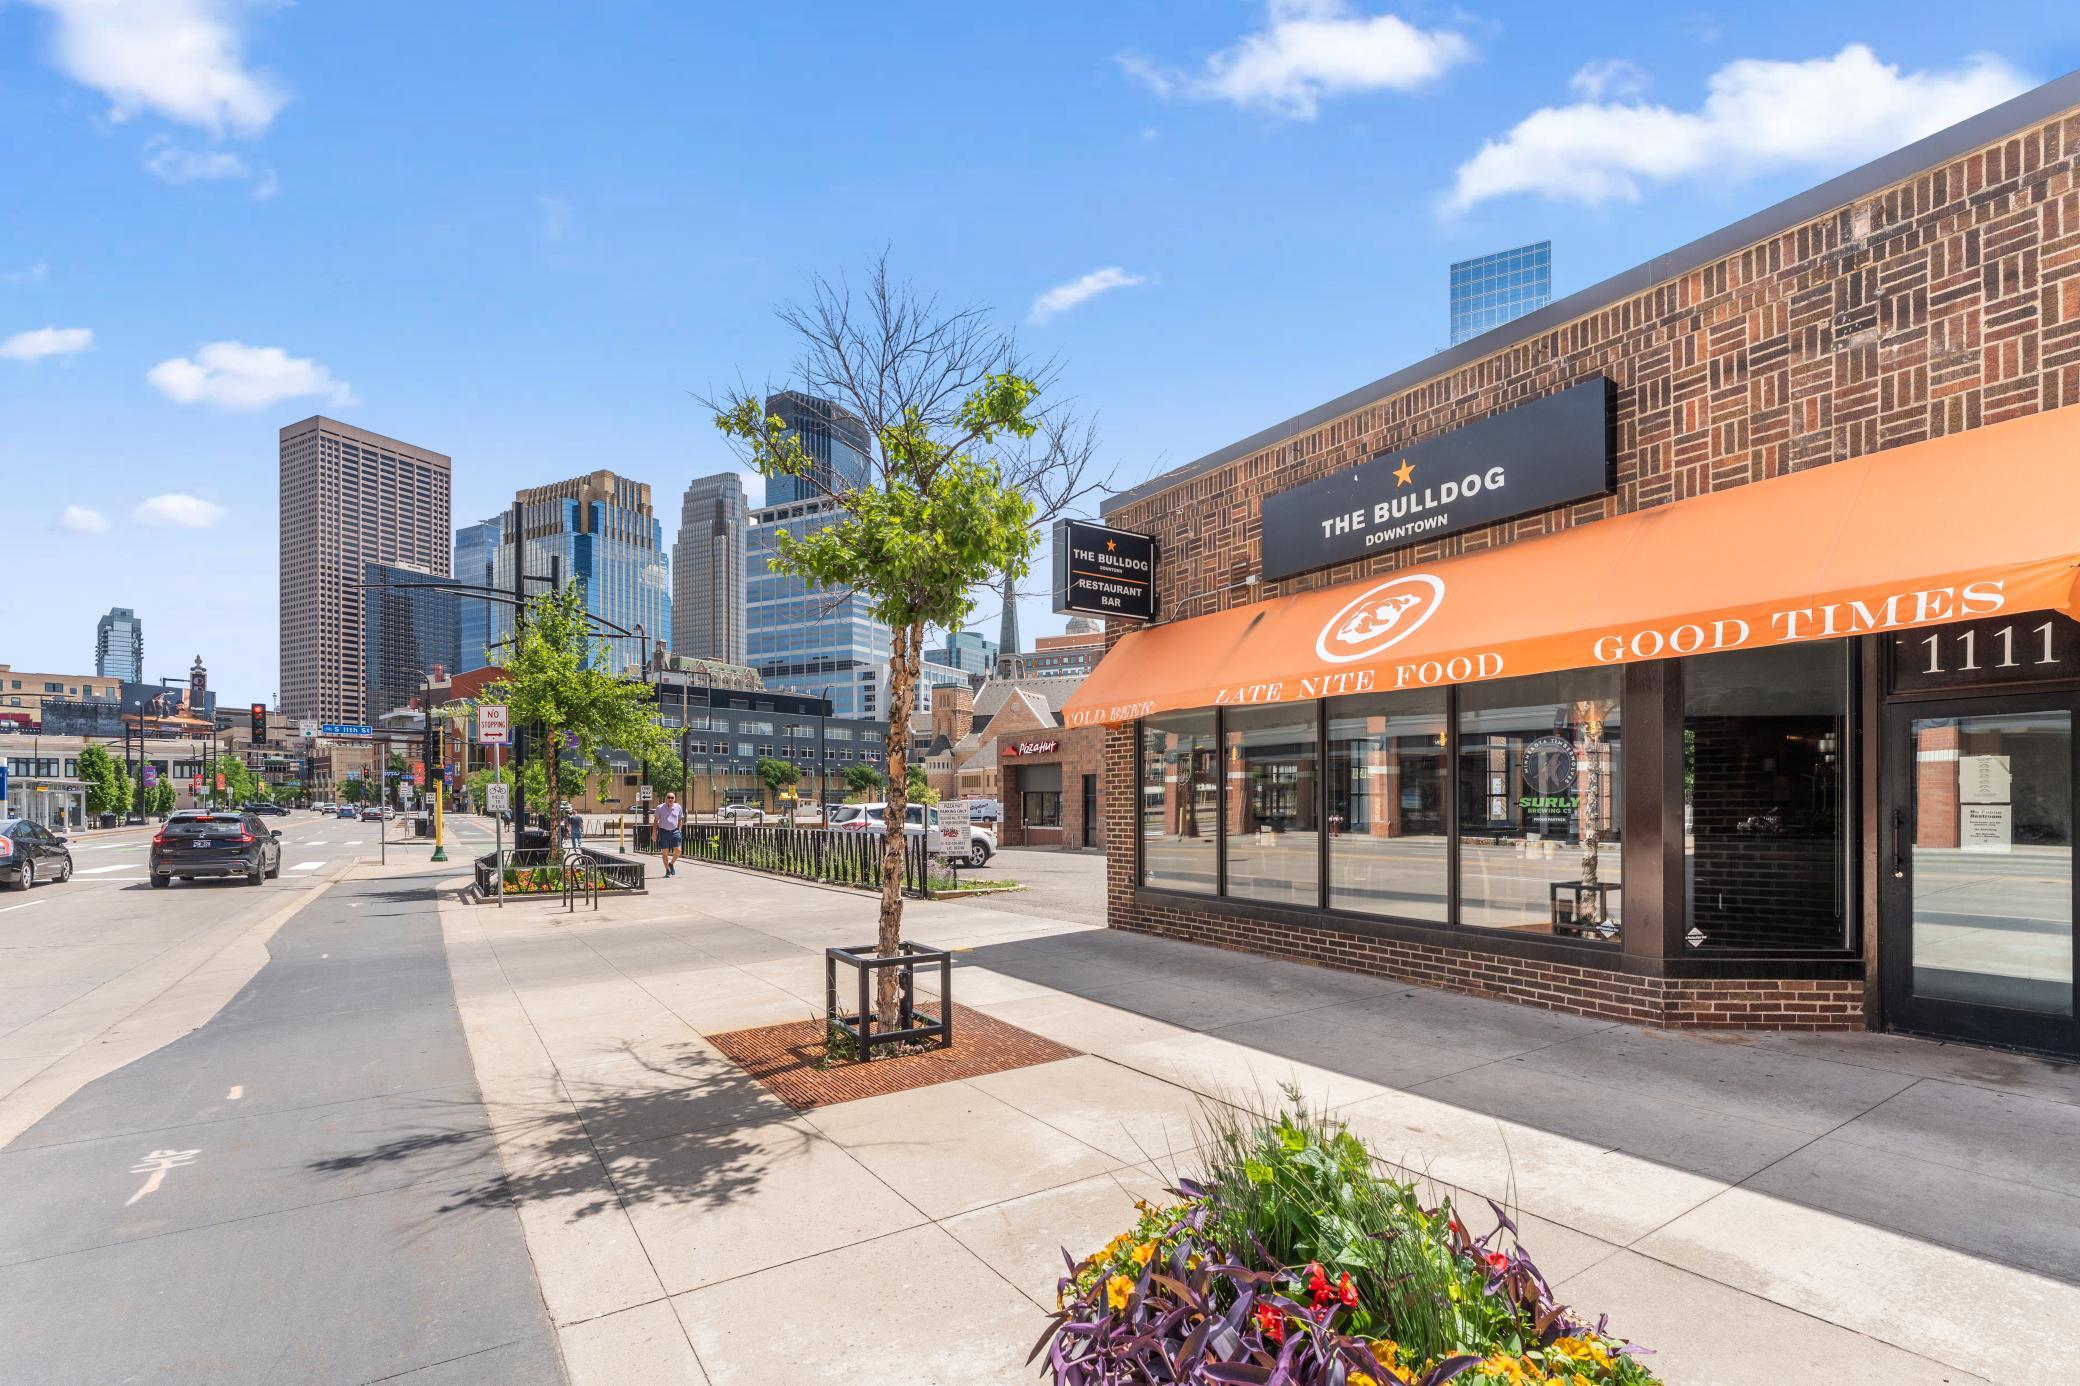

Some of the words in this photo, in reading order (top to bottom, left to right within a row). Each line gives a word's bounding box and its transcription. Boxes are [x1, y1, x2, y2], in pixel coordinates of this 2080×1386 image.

[1321, 509, 1366, 539] THE
[1374, 466, 1505, 524] BULLDOG
[1365, 513, 1448, 546] DOWNTOWN
[1073, 549, 1095, 562] THE
[1098, 553, 1149, 571] BULLDOG
[1099, 565, 1123, 574] DOWNTOWN
[1079, 579, 1142, 597] RESTAURANT
[1101, 596, 1121, 607] BAR
[1593, 619, 1750, 662] GOOD
[1771, 579, 2005, 642] TIMES
[1921, 621, 2061, 674] 1111
[1214, 682, 1283, 704] LATE
[1296, 669, 1376, 698] NITE
[1393, 652, 1504, 689] FOOD
[1065, 708, 1105, 727] COLD
[1109, 700, 1155, 721] BEER
[1519, 797, 1580, 808] SURLY
